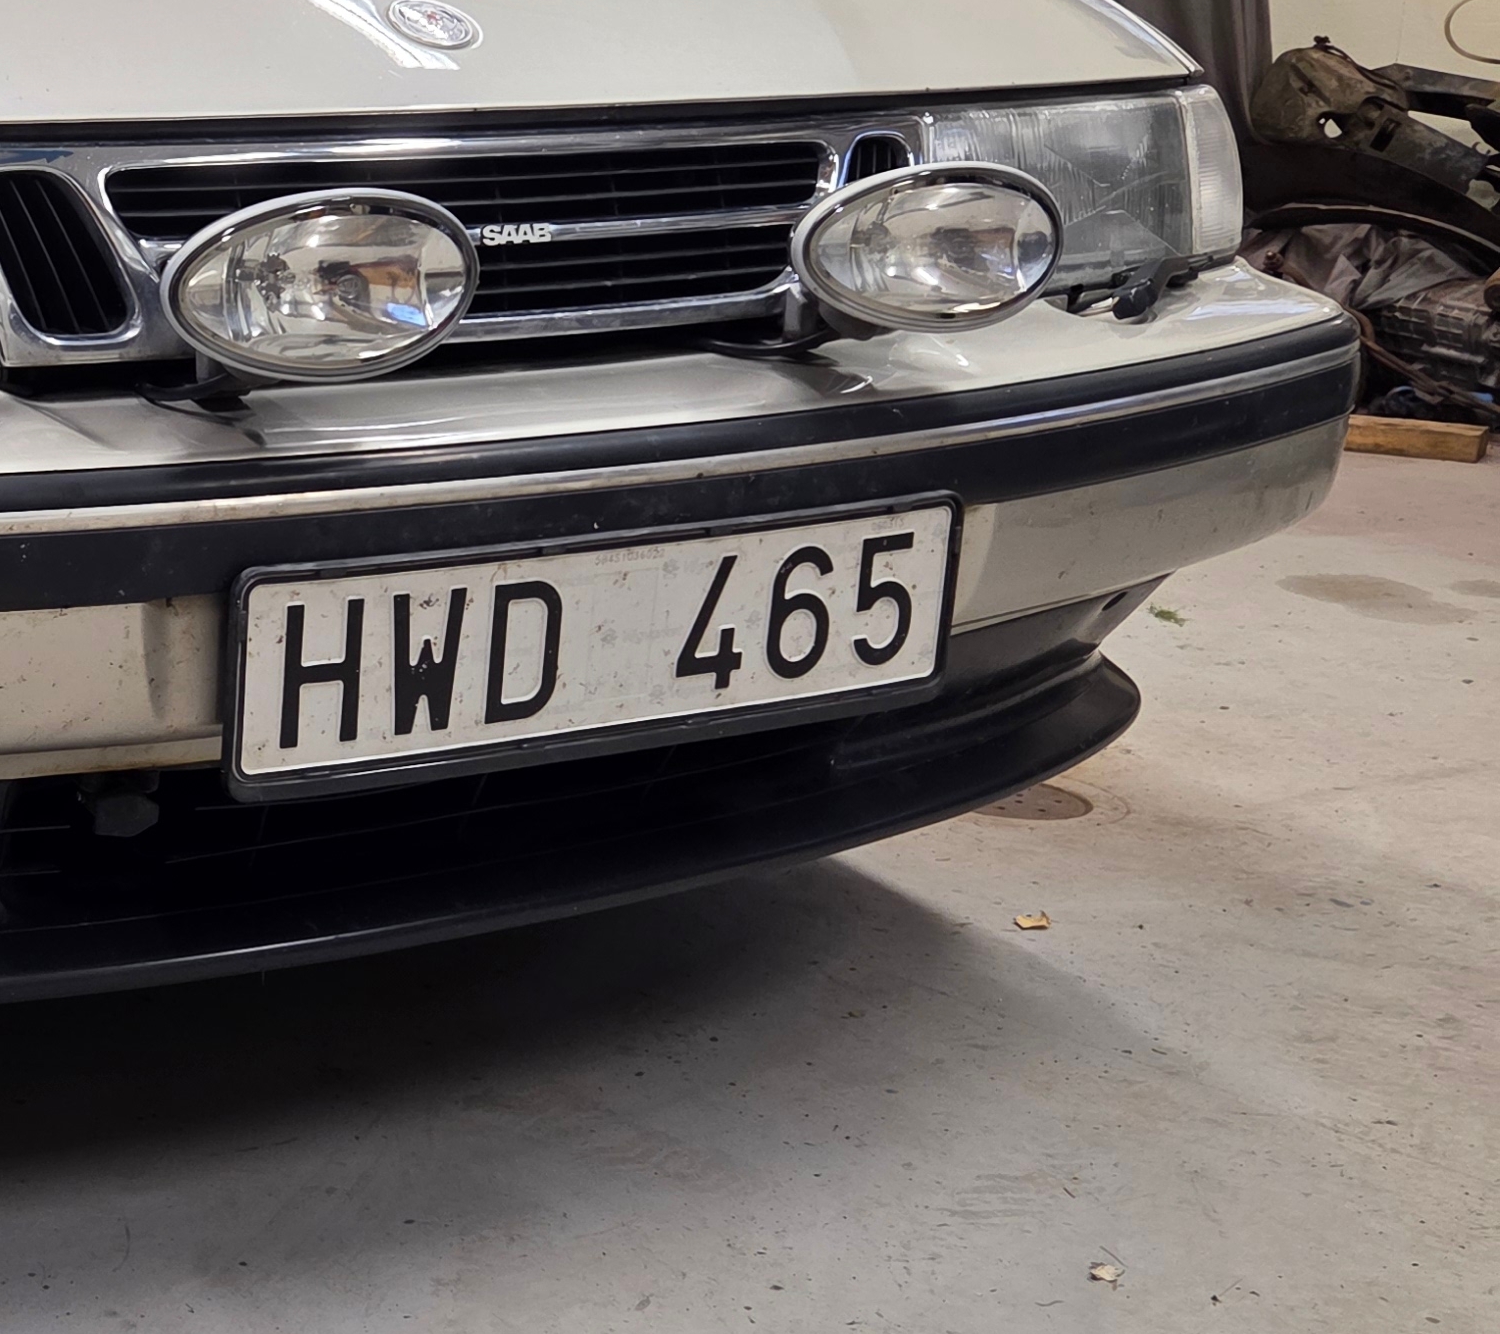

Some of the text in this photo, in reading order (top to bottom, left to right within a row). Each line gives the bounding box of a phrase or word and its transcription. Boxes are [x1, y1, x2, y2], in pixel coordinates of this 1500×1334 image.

[482, 222, 552, 246] SAAB
[279, 532, 915, 749] HWD 465
